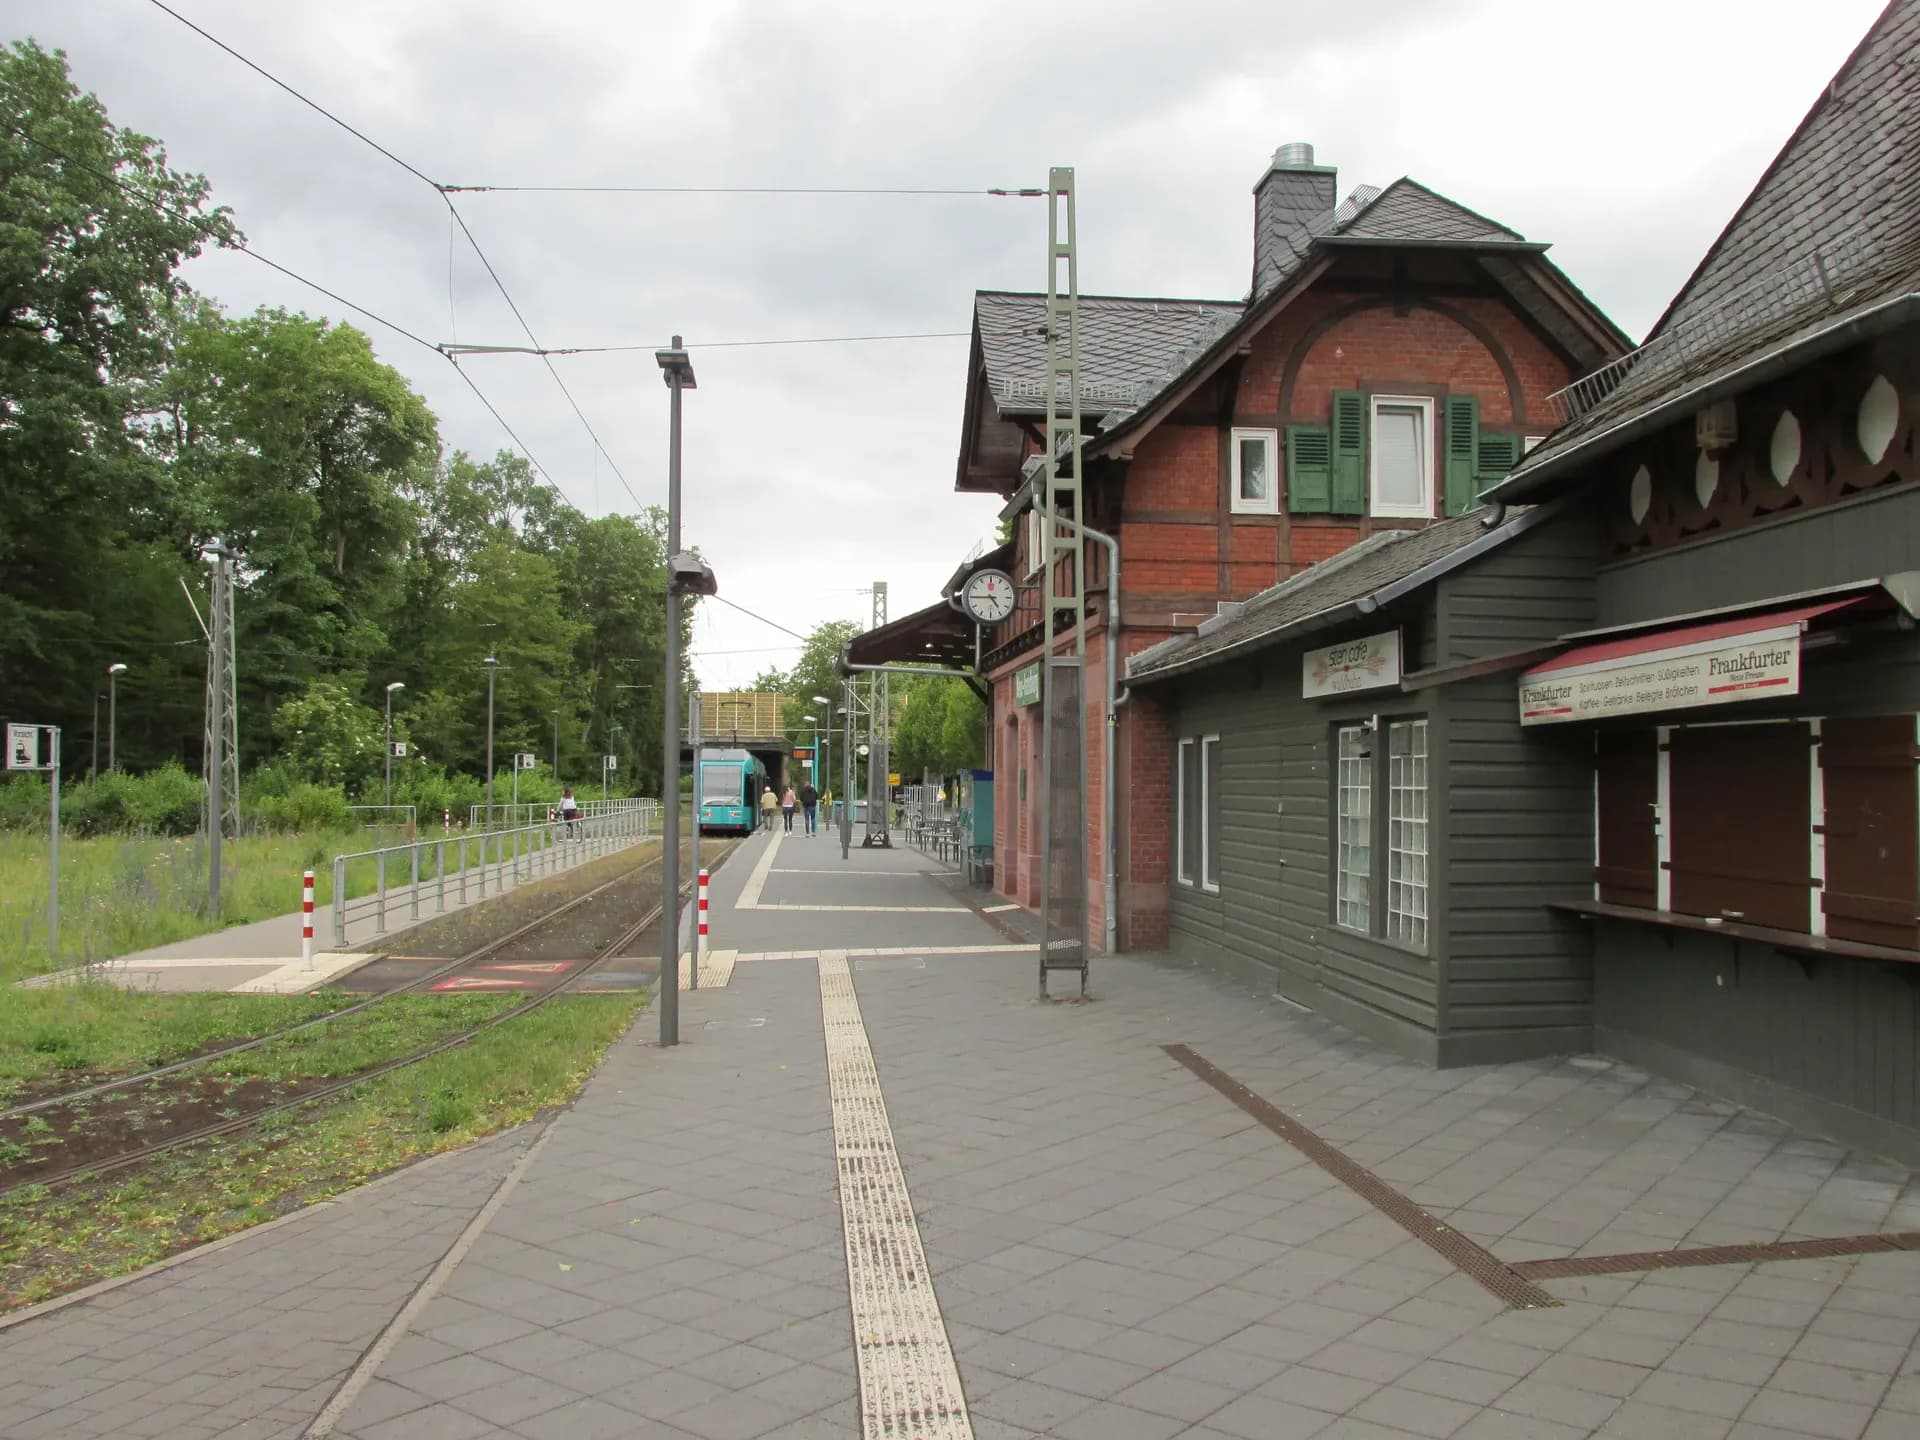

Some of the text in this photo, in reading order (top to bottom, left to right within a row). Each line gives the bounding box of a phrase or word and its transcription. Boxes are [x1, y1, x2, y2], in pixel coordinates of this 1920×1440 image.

[1709, 648, 1791, 676] Frankfurter
[1657, 665, 1699, 681] Süßigkeiten
[1523, 686, 1573, 704] Frankfurter
[1665, 685, 1699, 699] Brötchen
